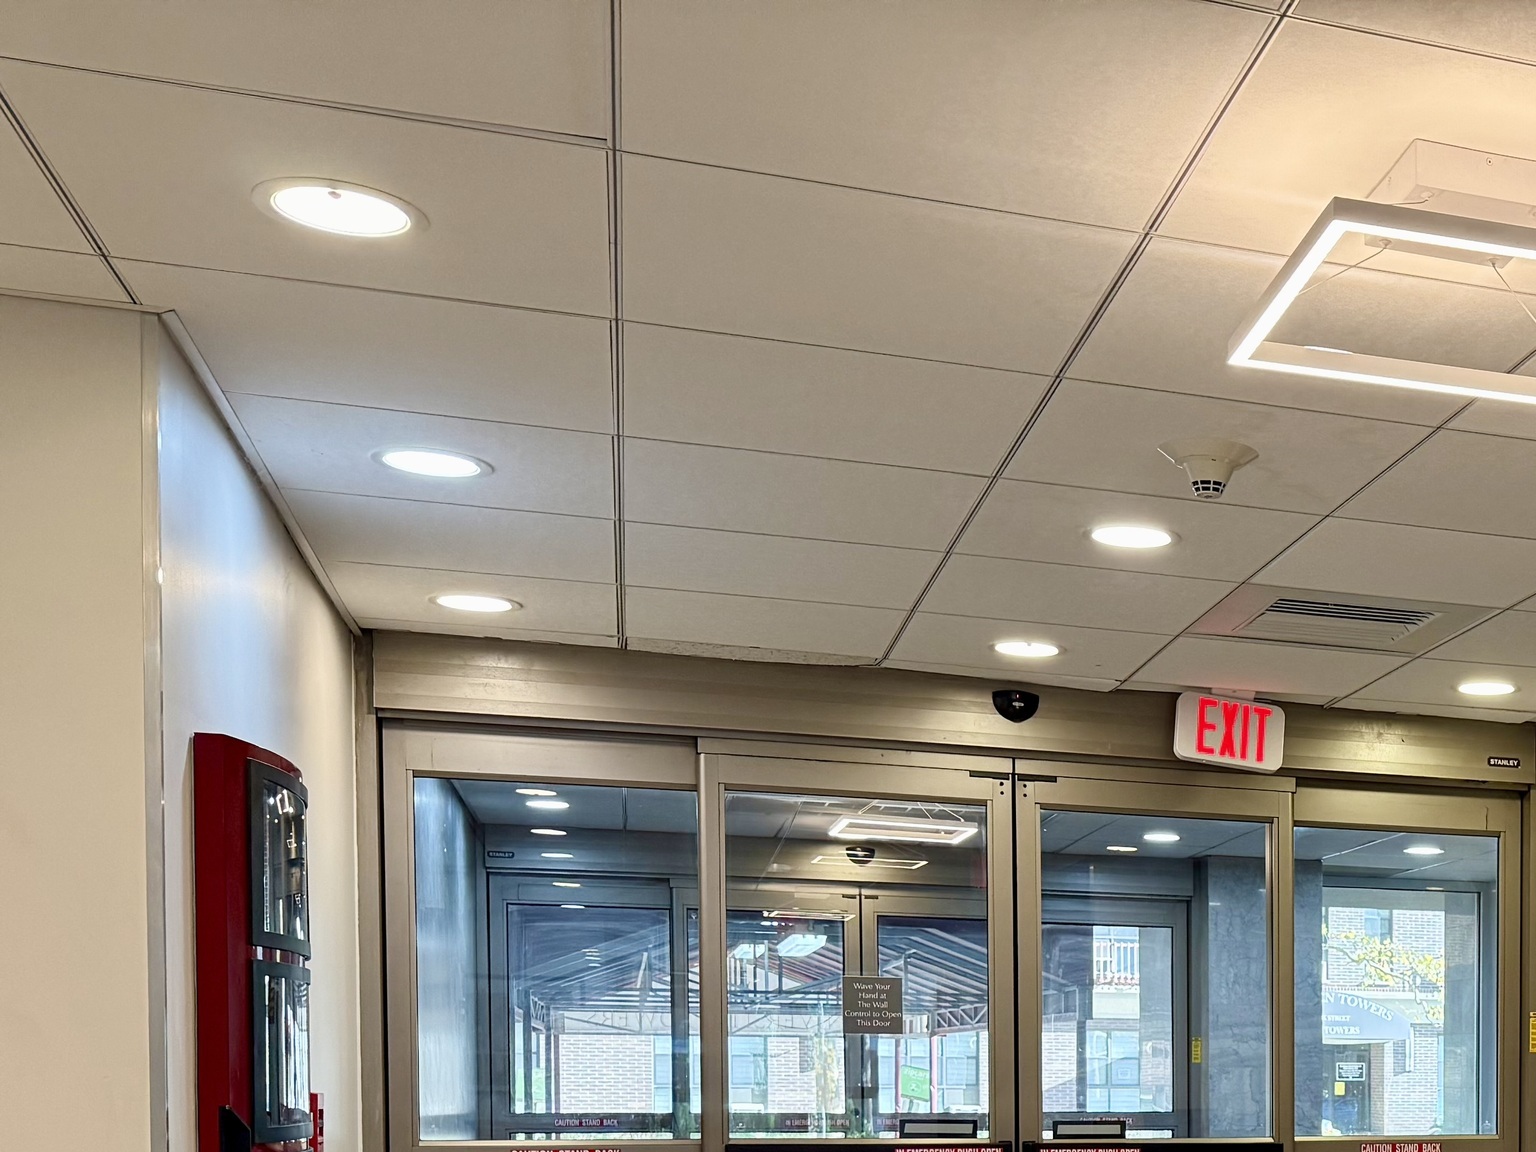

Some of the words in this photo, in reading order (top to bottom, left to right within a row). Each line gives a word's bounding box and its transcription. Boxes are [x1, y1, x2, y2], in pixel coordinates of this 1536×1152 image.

[1196, 696, 1273, 764] EXIT
[1338, 993, 1394, 1021] TOWERS
[882, 1011, 902, 1019] Open
[872, 1019, 891, 1027] Door
[1324, 1026, 1360, 1034] TOWERS
[555, 1119, 579, 1127] CAUTION
[603, 1118, 618, 1127] BACK
[1396, 1143, 1419, 1152] STAND
